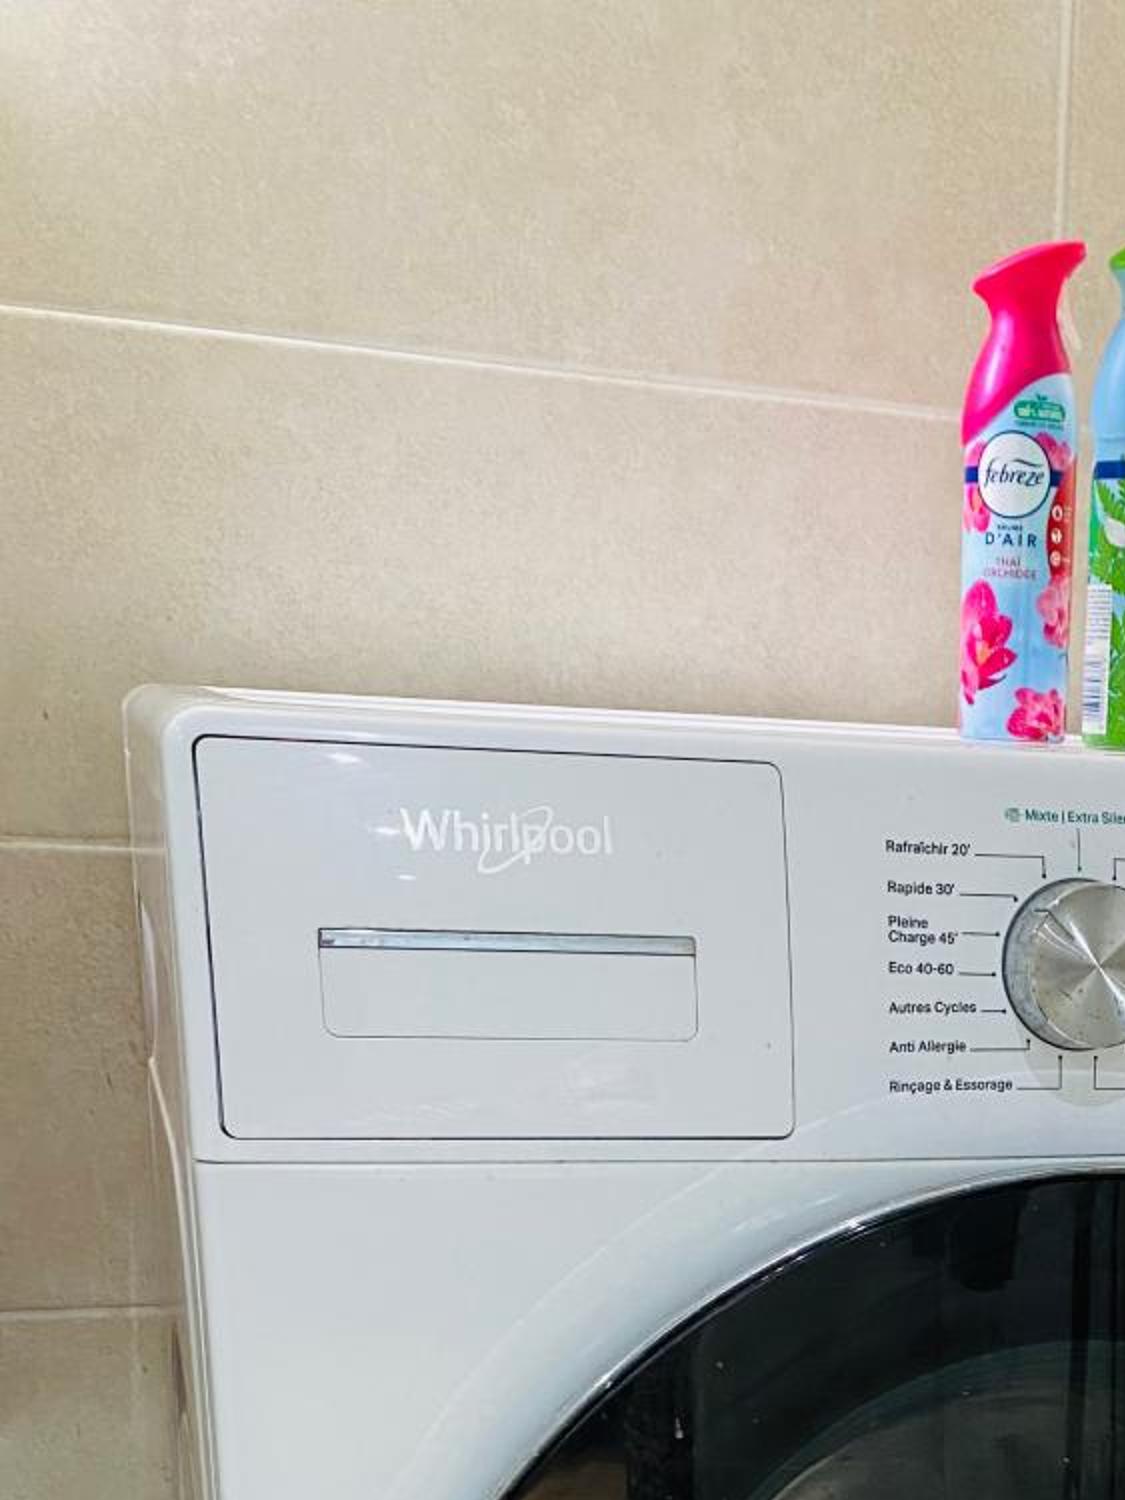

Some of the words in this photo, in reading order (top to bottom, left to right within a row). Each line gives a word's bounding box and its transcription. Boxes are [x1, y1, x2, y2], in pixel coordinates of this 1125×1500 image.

[984, 458, 1045, 488] febreze
[985, 531, 1038, 548] D'AIR
[1025, 809, 1059, 821] Mixte
[1067, 811, 1099, 823] Extra
[400, 806, 612, 874] Whirlpool
[887, 880, 933, 896] Rapide
[887, 914, 928, 929] Pleine
[887, 929, 936, 947] Charge
[888, 961, 913, 974] Eco
[916, 962, 955, 975] 40-60
[889, 1001, 931, 1014] Autres
[934, 1001, 977, 1016] Cycles
[889, 1041, 915, 1053] Anti
[918, 1040, 967, 1055] Allergie
[889, 1080, 941, 1095] Rinçage
[943, 1079, 953, 1091] &
[955, 1079, 1013, 1093] Essorage
